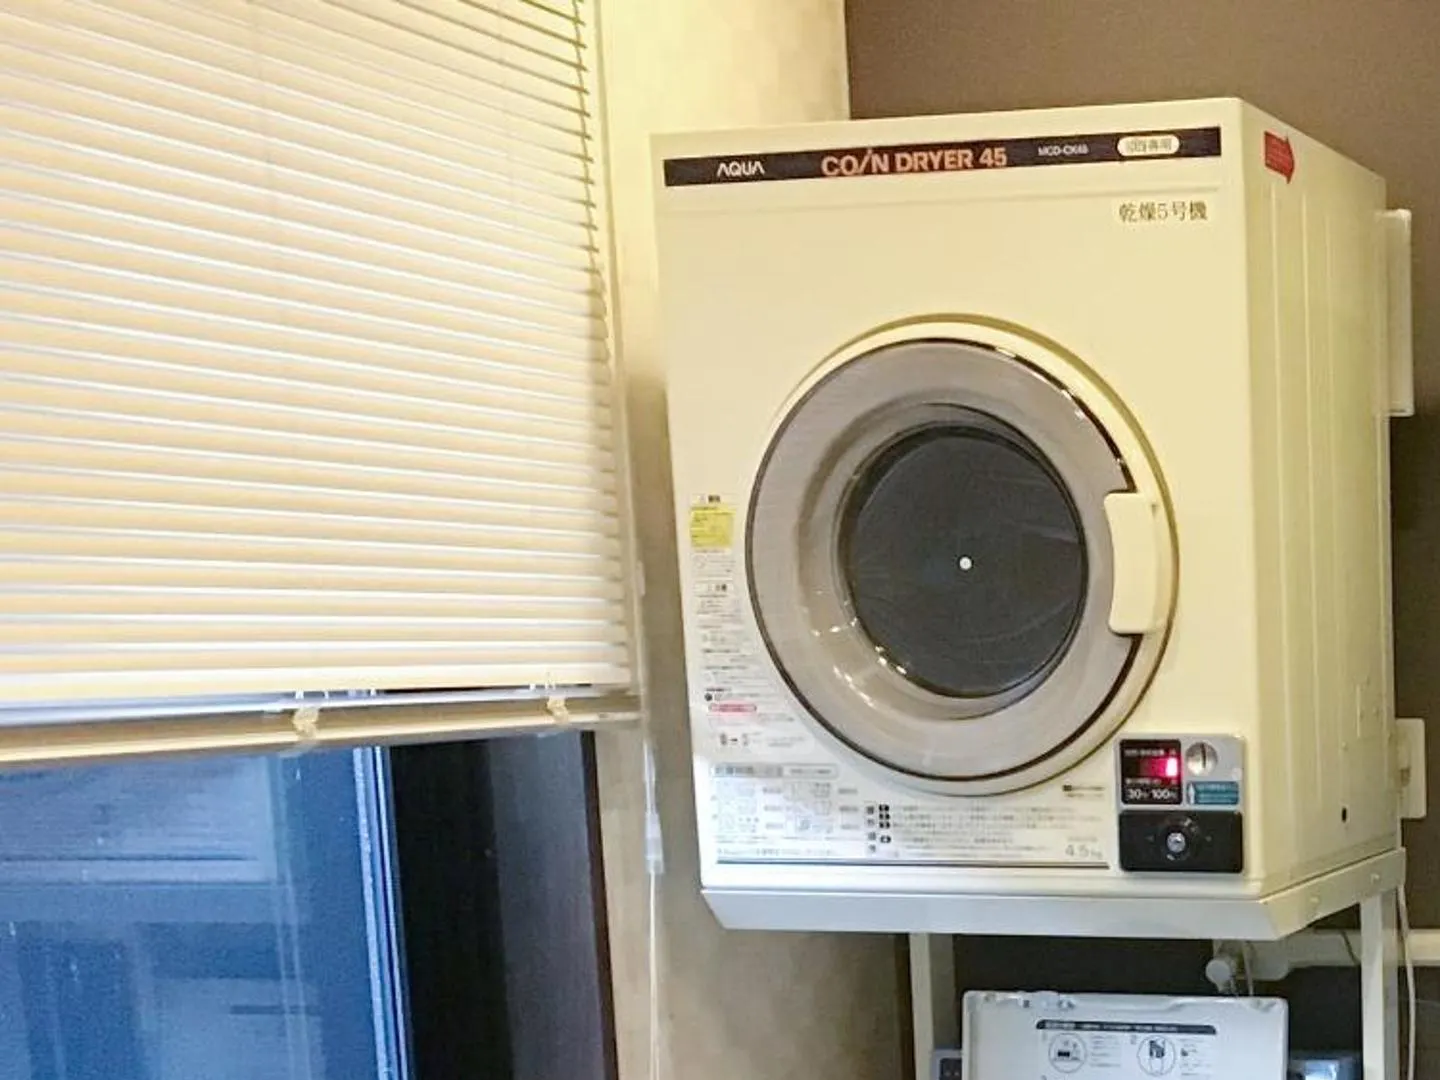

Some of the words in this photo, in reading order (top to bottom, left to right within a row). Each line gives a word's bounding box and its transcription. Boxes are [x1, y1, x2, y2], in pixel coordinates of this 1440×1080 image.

[716, 160, 766, 177] AQUA
[895, 148, 973, 173] DRYER
[978, 147, 1008, 168] 45
[1118, 201, 1208, 222] 乾燥5号機
